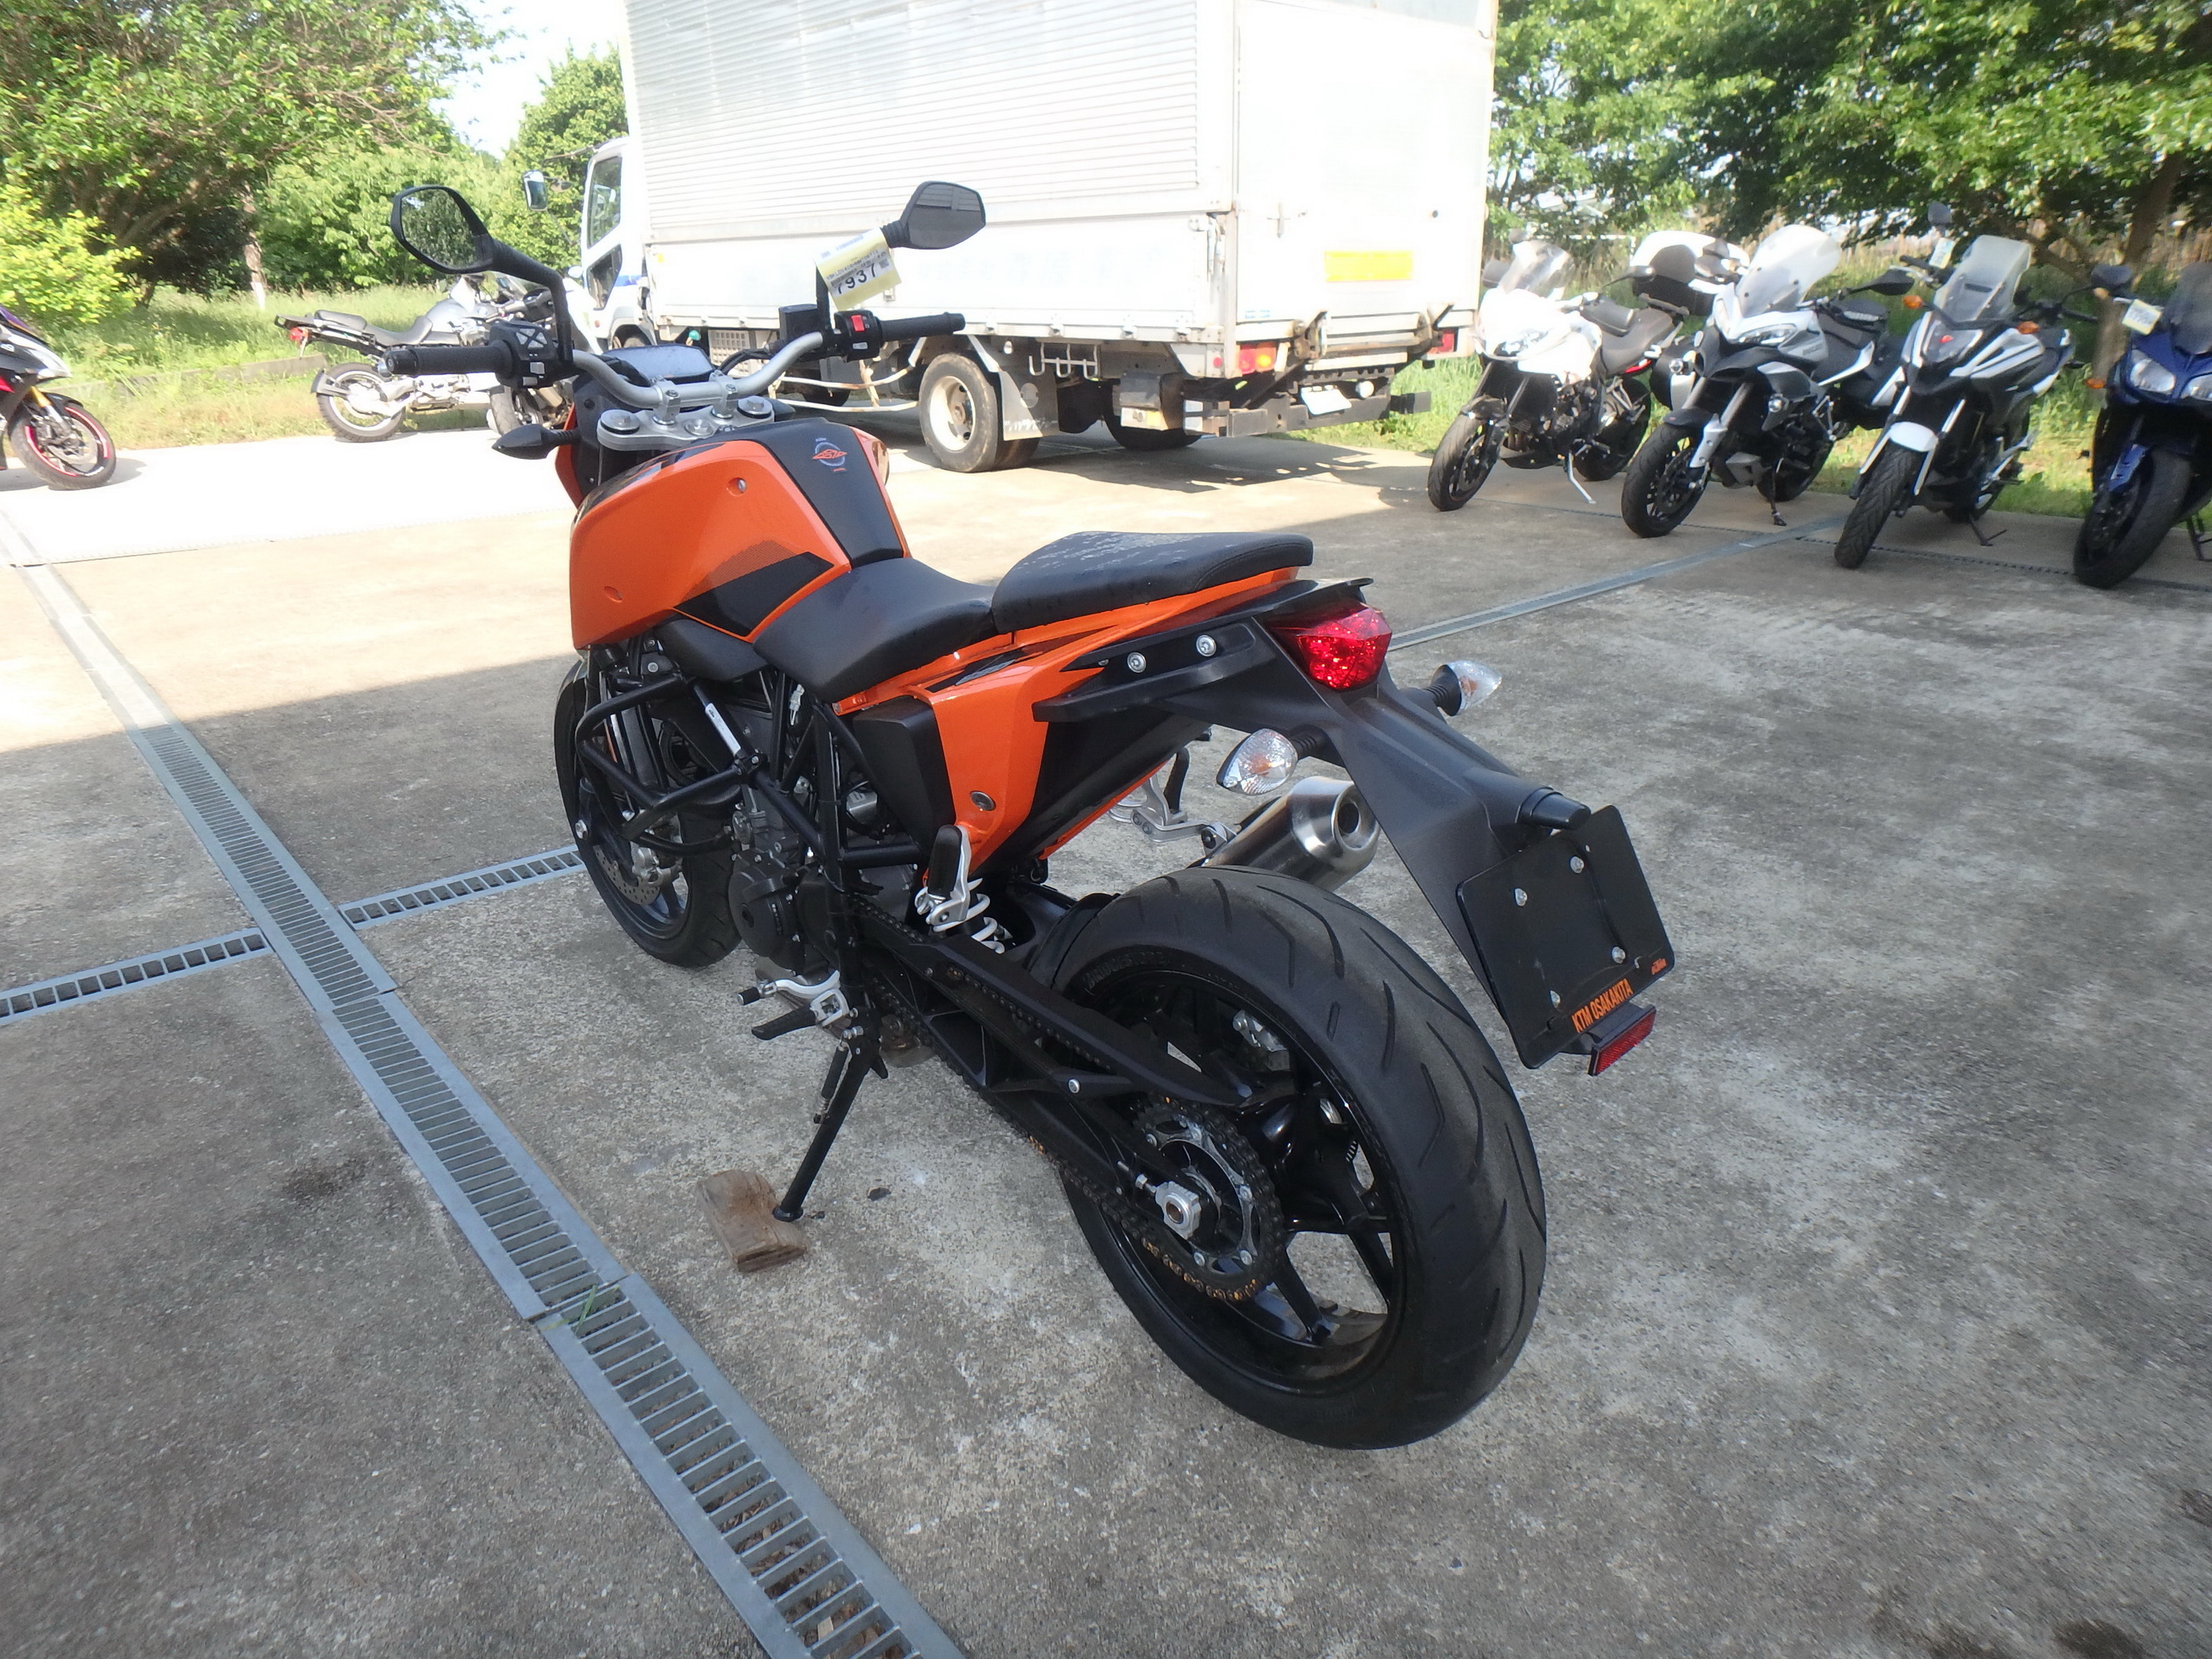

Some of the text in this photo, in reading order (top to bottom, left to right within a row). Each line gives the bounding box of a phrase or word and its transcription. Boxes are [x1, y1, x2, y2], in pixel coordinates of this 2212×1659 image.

[835, 263, 876, 294] 7937
[1571, 978, 1633, 1033] KTM OSAKAKITA
